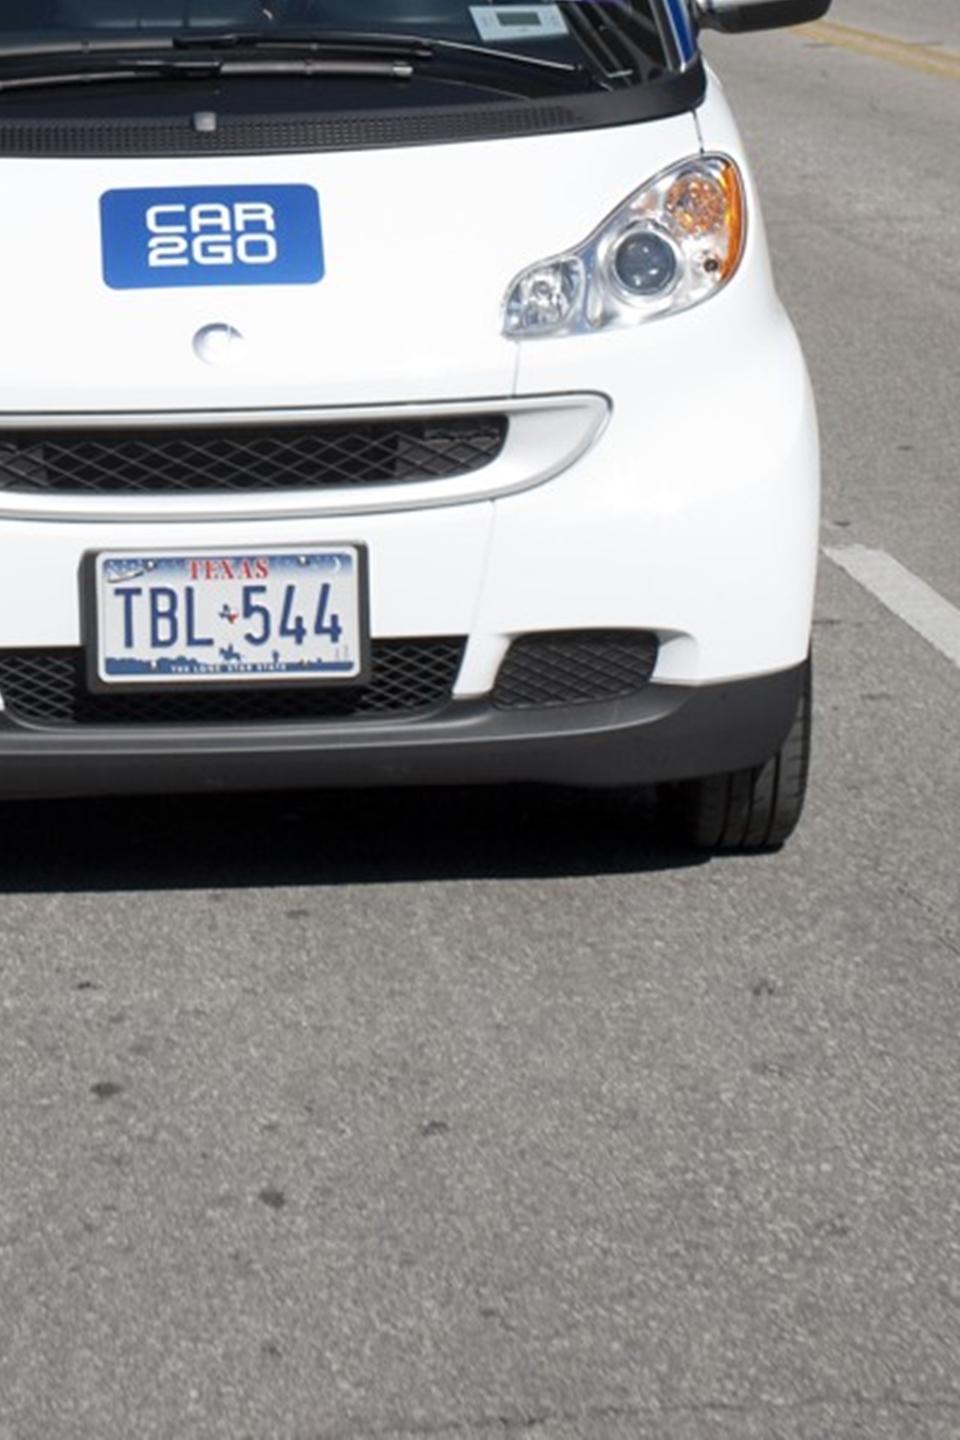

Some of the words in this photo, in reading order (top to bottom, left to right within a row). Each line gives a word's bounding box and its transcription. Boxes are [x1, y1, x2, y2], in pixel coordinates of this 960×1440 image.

[145, 202, 275, 234] CAR
[147, 233, 277, 267] 2GO
[189, 558, 269, 581] TEXAS
[114, 584, 214, 648] TBL
[242, 582, 343, 646] 544
